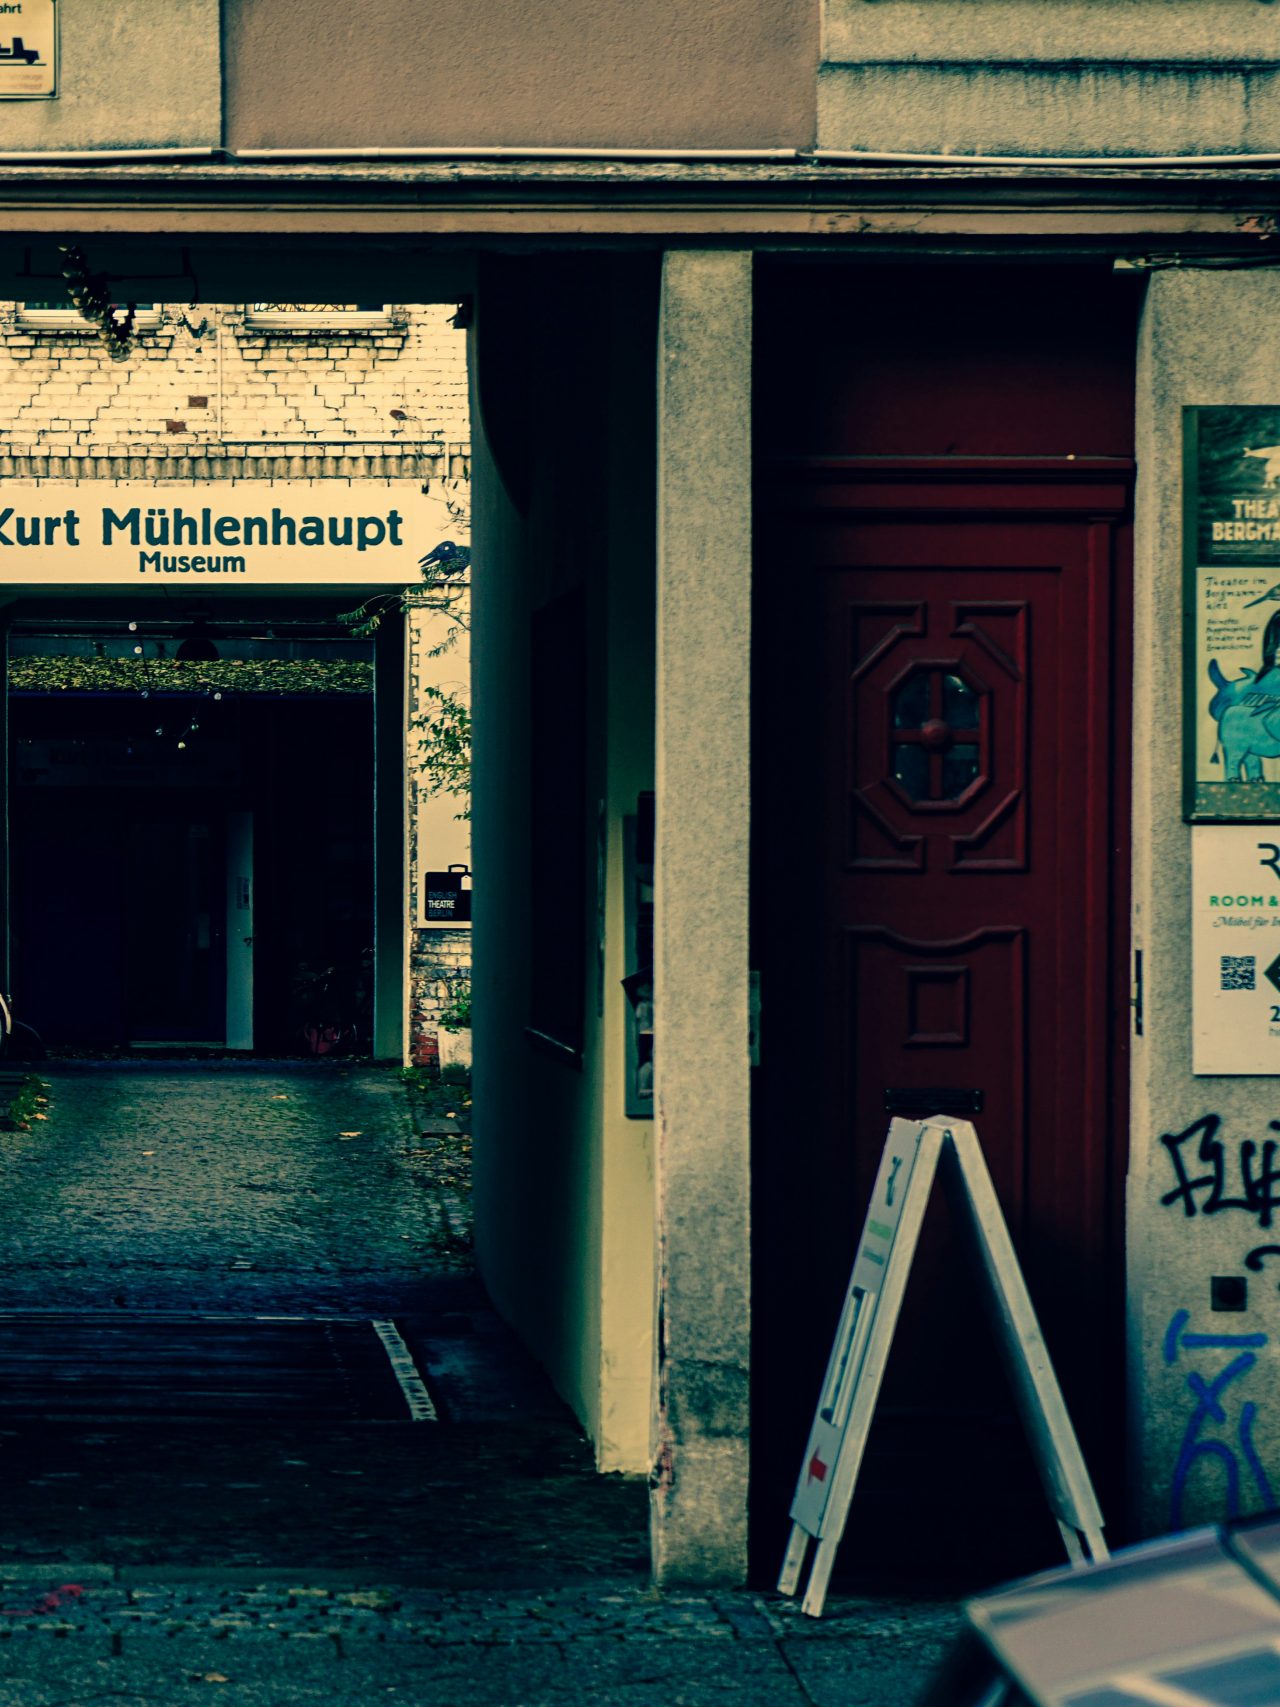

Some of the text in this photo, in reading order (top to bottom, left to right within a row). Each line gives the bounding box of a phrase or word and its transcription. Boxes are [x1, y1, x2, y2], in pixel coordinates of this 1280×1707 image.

[102, 507, 403, 551] Mühlenhaupt
[139, 551, 246, 573] Museum
[428, 900, 455, 909] THEATRE
[1210, 896, 1279, 907] ROOM &
